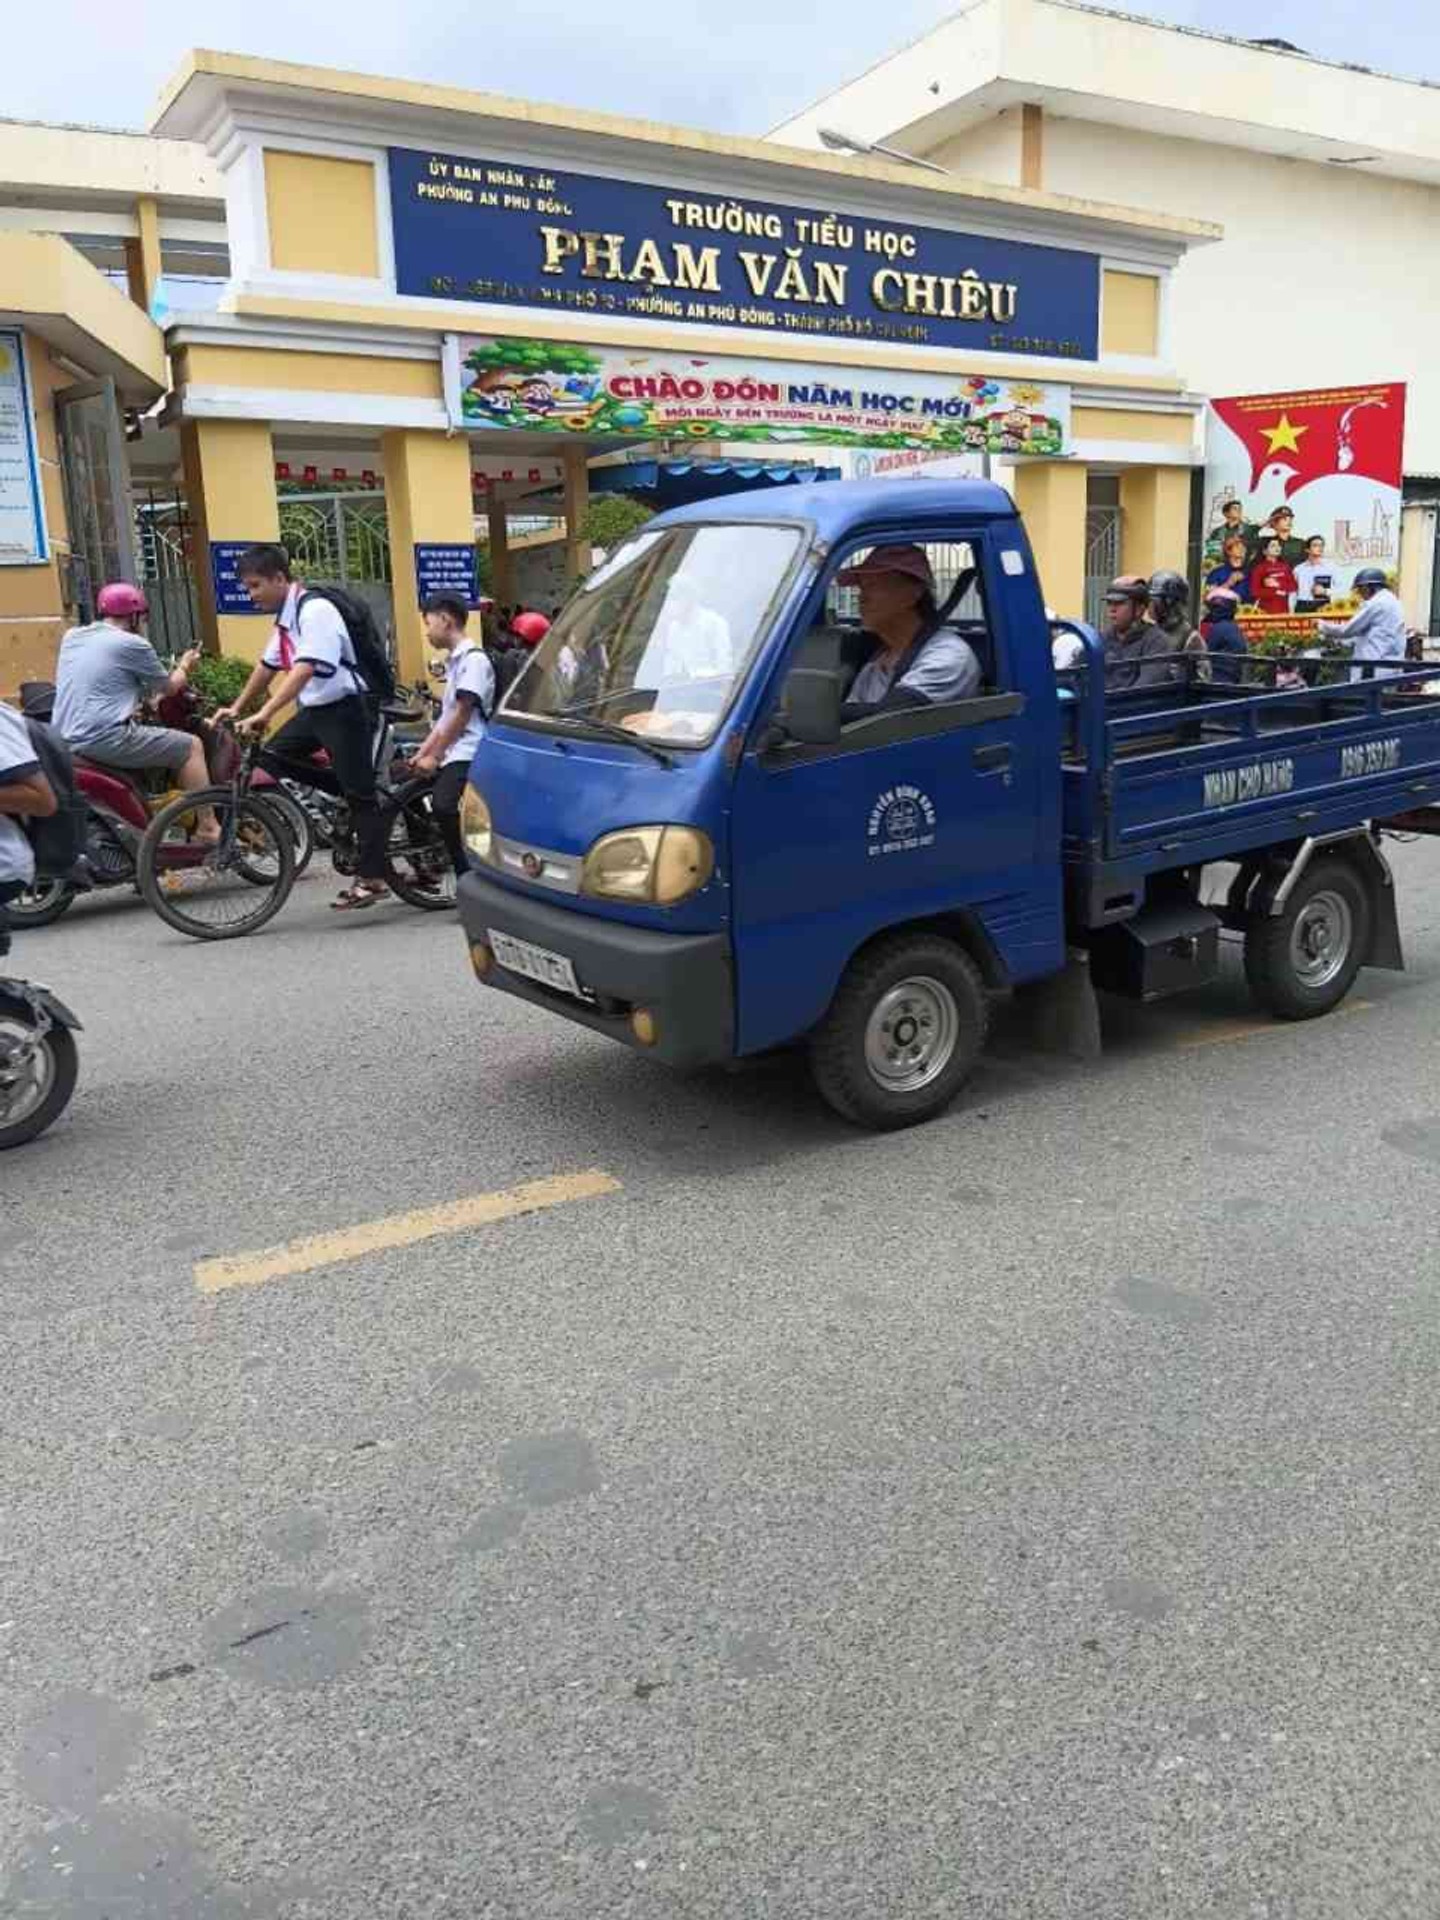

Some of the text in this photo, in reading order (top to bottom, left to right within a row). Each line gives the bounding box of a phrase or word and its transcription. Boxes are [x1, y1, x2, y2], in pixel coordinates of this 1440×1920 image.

[454, 164, 481, 182] BAN
[480, 190, 498, 206] AN
[666, 199, 917, 261] TRƯỜNG TIỂU HỌC
[739, 246, 848, 306] VĂN
[872, 267, 1019, 324] CHIÊU
[687, 302, 706, 319] AN
[609, 371, 972, 418] CHÀO ĐÓN NĂM HỌC MỚI
